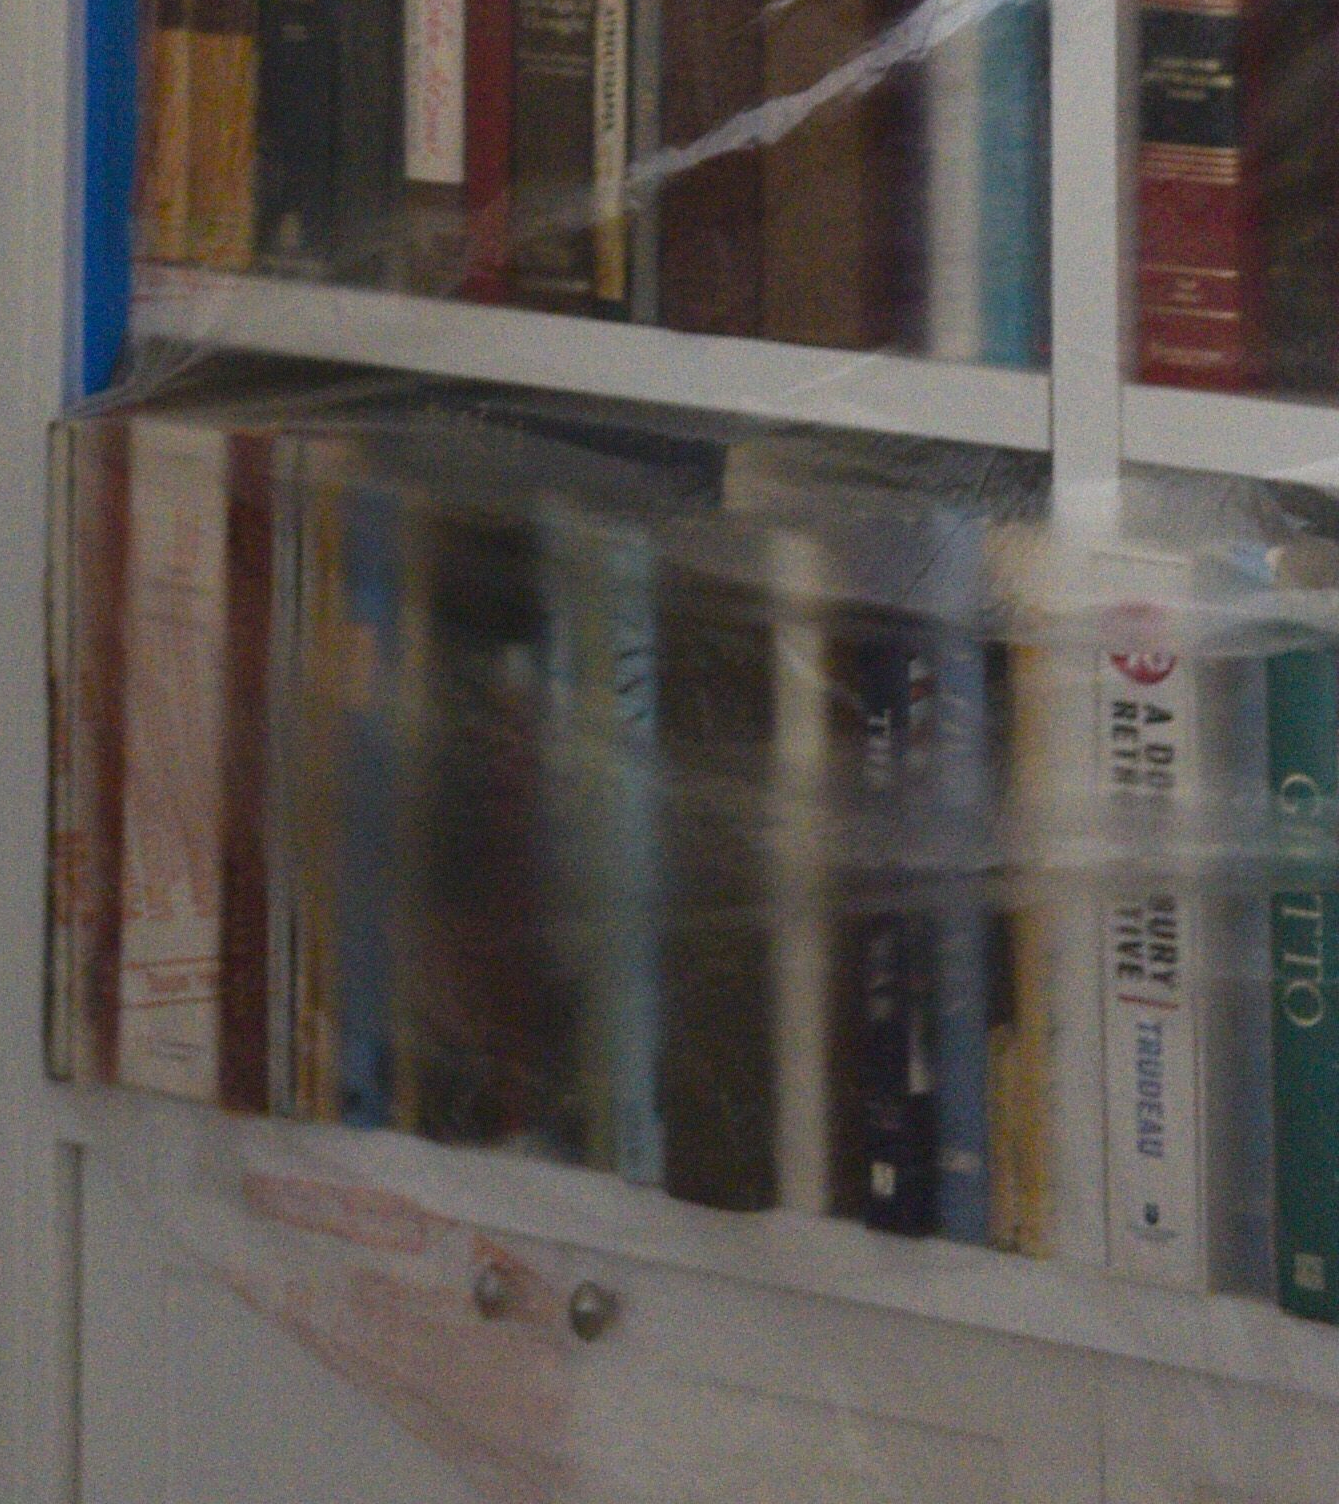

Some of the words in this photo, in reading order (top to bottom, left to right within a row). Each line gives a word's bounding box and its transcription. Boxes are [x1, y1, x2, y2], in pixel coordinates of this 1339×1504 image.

[1145, 703, 1174, 725] A
[1280, 772, 1324, 1027] GITTO
[1135, 1019, 1164, 1159] TRUDEAU
